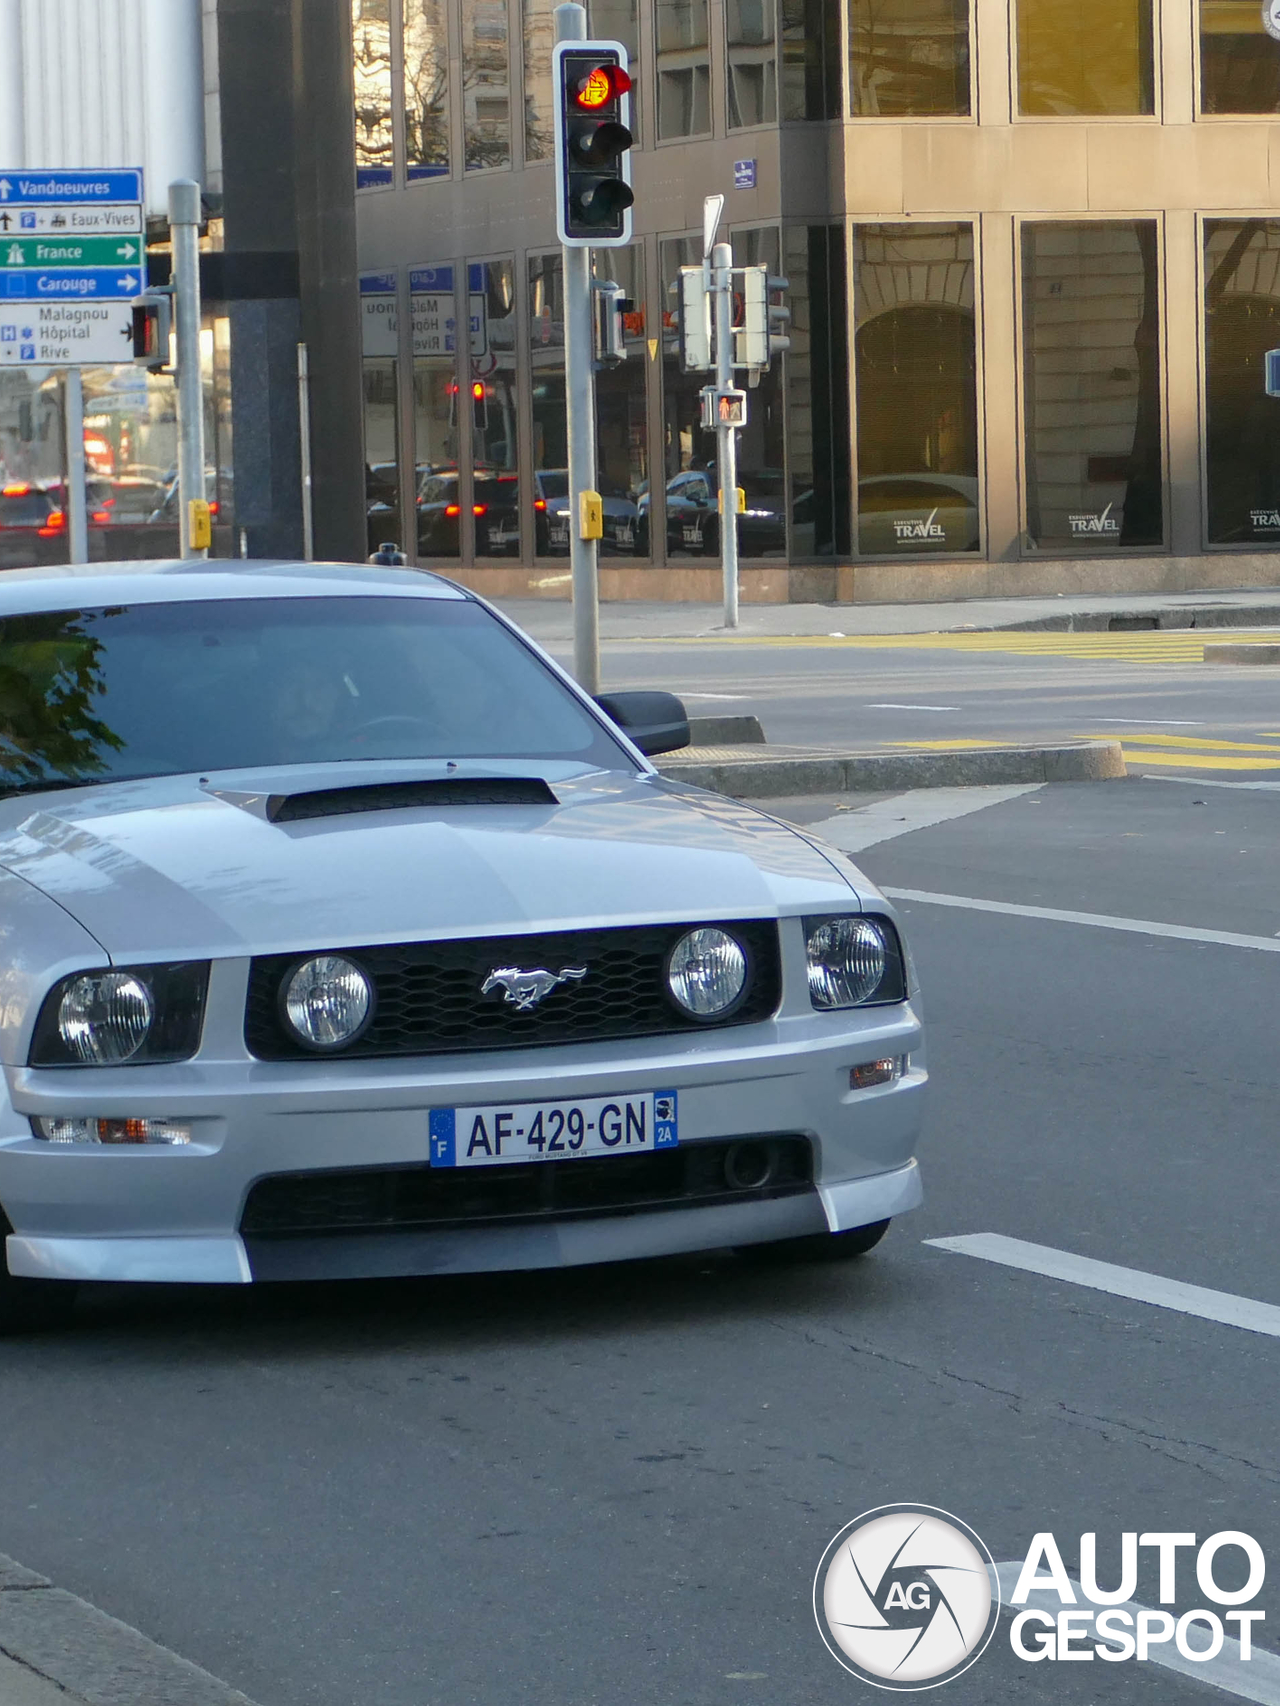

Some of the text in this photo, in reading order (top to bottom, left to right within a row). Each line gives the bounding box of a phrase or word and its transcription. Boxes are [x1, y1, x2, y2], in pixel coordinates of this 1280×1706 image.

[19, 180, 110, 195] Vandoeuvres
[71, 212, 135, 226] Eaux-Vives
[36, 245, 83, 259] France
[37, 276, 97, 294] Carouge
[40, 307, 109, 323] Malagnou
[40, 325, 90, 341] Hôpital
[41, 346, 70, 357] Rive
[466, 1101, 646, 1157] AF-429-GN
[657, 1126, 672, 1142] 2A
[437, 1141, 447, 1158] F
